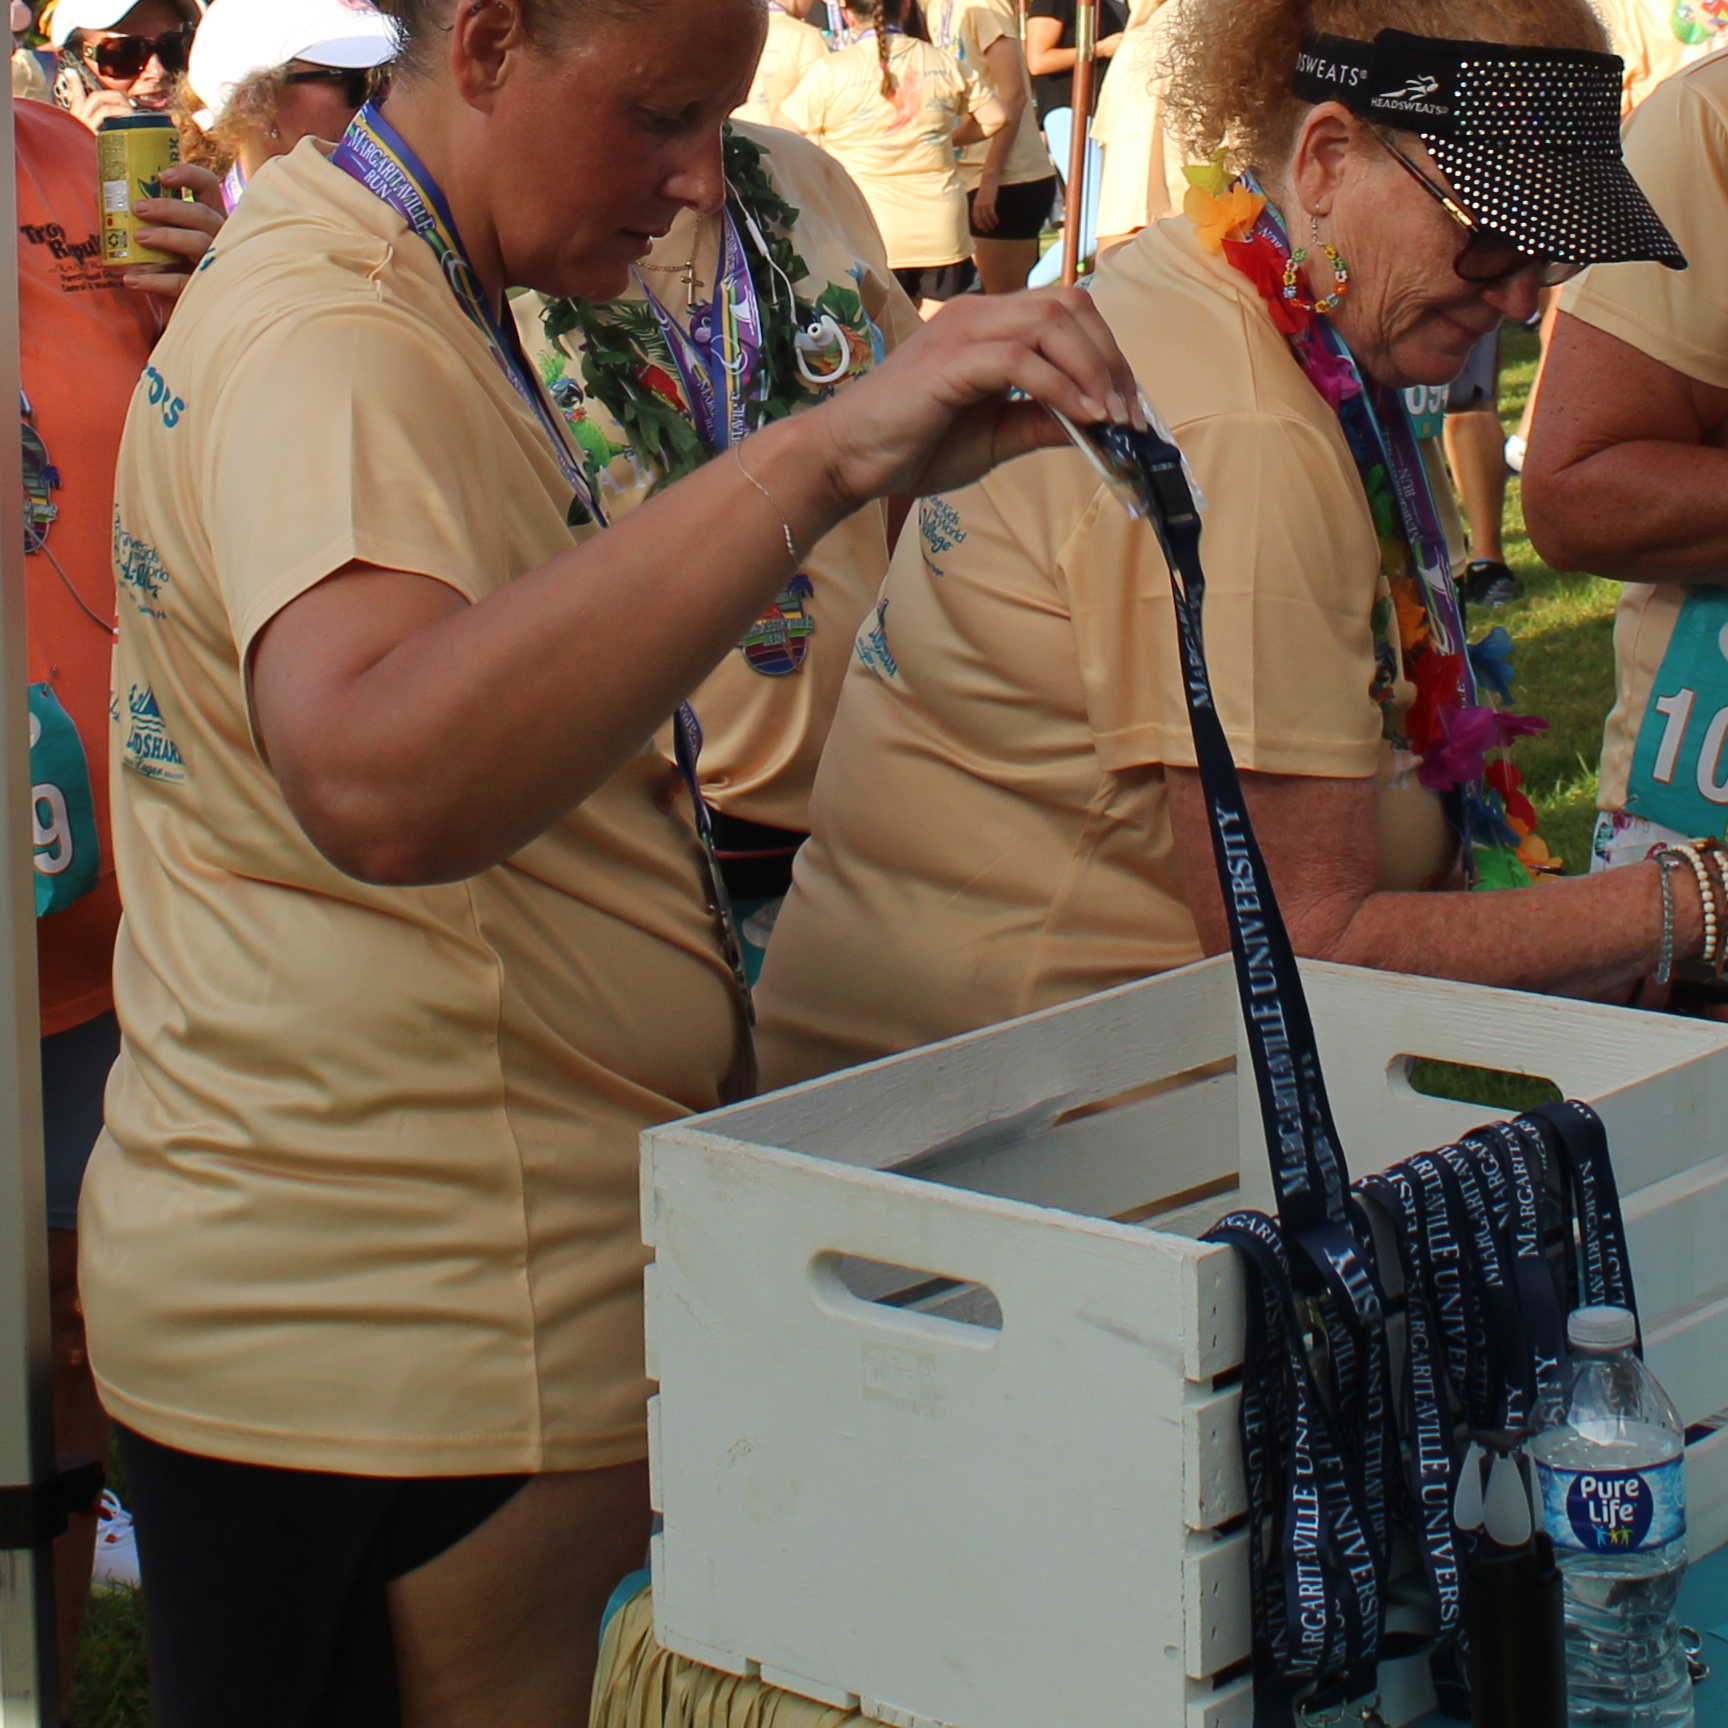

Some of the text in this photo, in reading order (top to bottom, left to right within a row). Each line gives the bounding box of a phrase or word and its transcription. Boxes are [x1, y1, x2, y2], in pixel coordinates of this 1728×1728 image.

[347, 127, 437, 235] MARGARITAVILLE
[363, 169, 392, 199] RUN
[1217, 804, 1278, 1001] UNIVERSITY
[1580, 1475, 1640, 1499] Pure
[1588, 1499, 1634, 1529] Life
